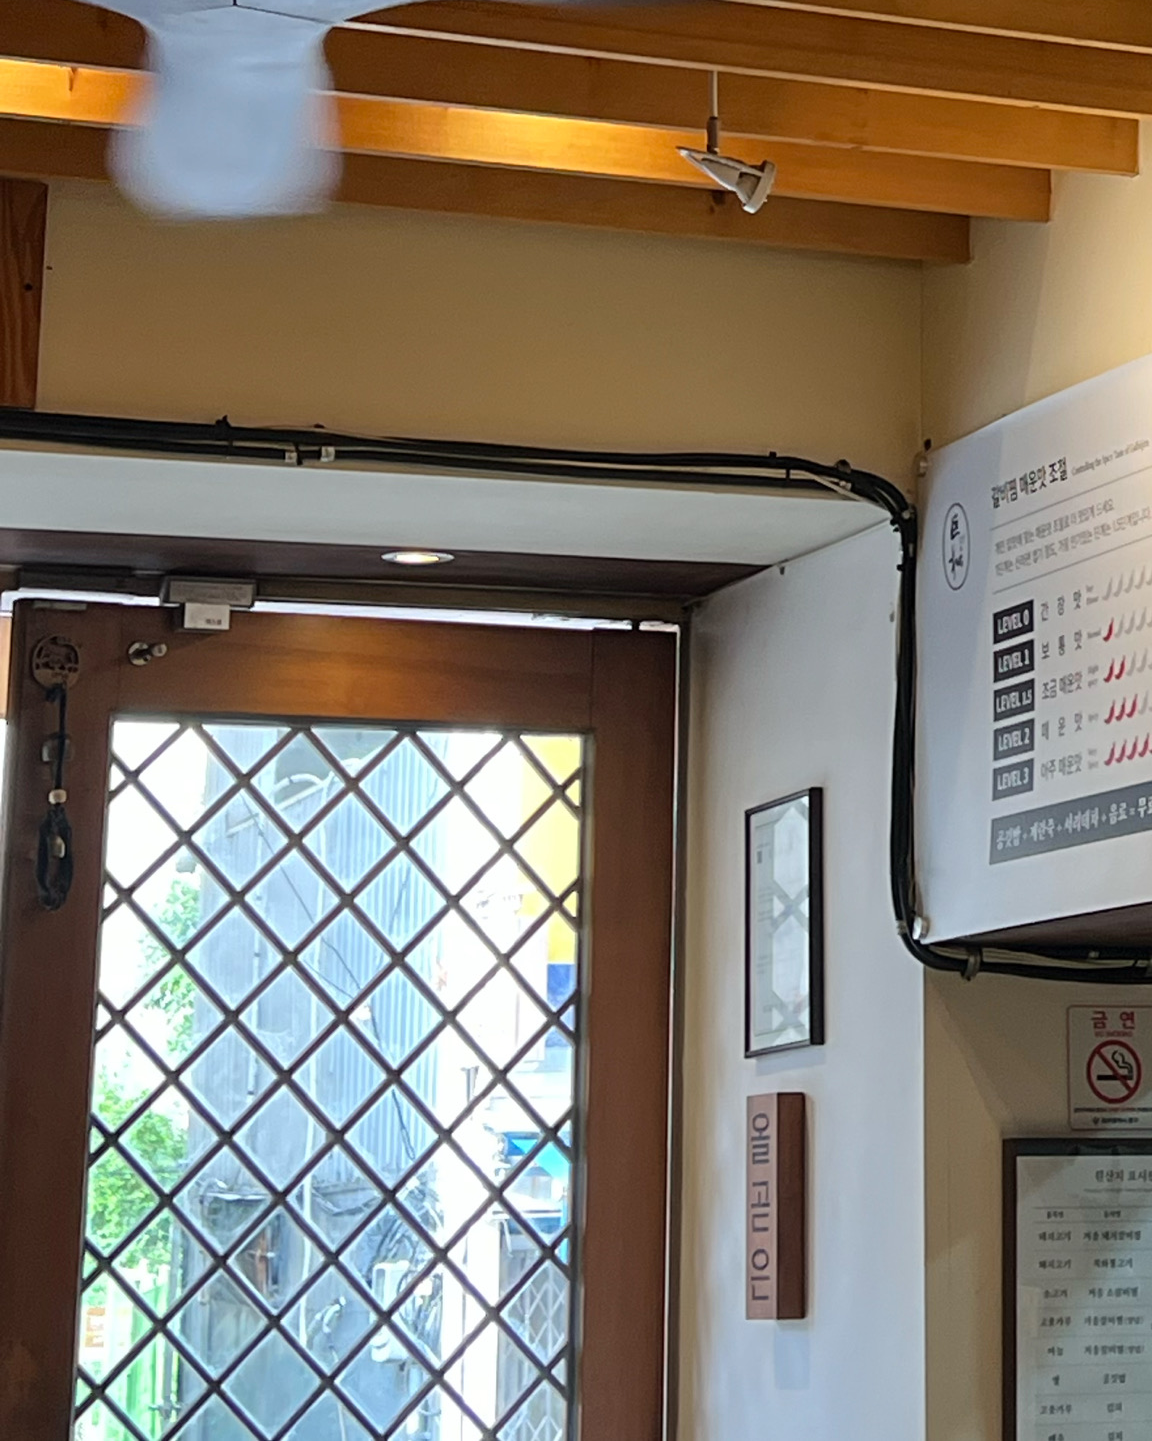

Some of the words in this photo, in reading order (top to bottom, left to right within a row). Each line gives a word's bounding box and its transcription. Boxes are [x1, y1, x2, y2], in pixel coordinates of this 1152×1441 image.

[1019, 465, 1047, 495] 매운맛
[997, 612, 1023, 634] LEVEL
[1023, 609, 1030, 625] 0
[998, 652, 1023, 673] LEVEL
[1024, 648, 1030, 665] 1
[996, 692, 1021, 713] LEVEL
[1022, 689, 1033, 705] 1.5
[998, 730, 1023, 751] LEVEL
[1023, 727, 1030, 745] 2
[997, 769, 1022, 791] LEVEL
[1022, 766, 1030, 784] 3
